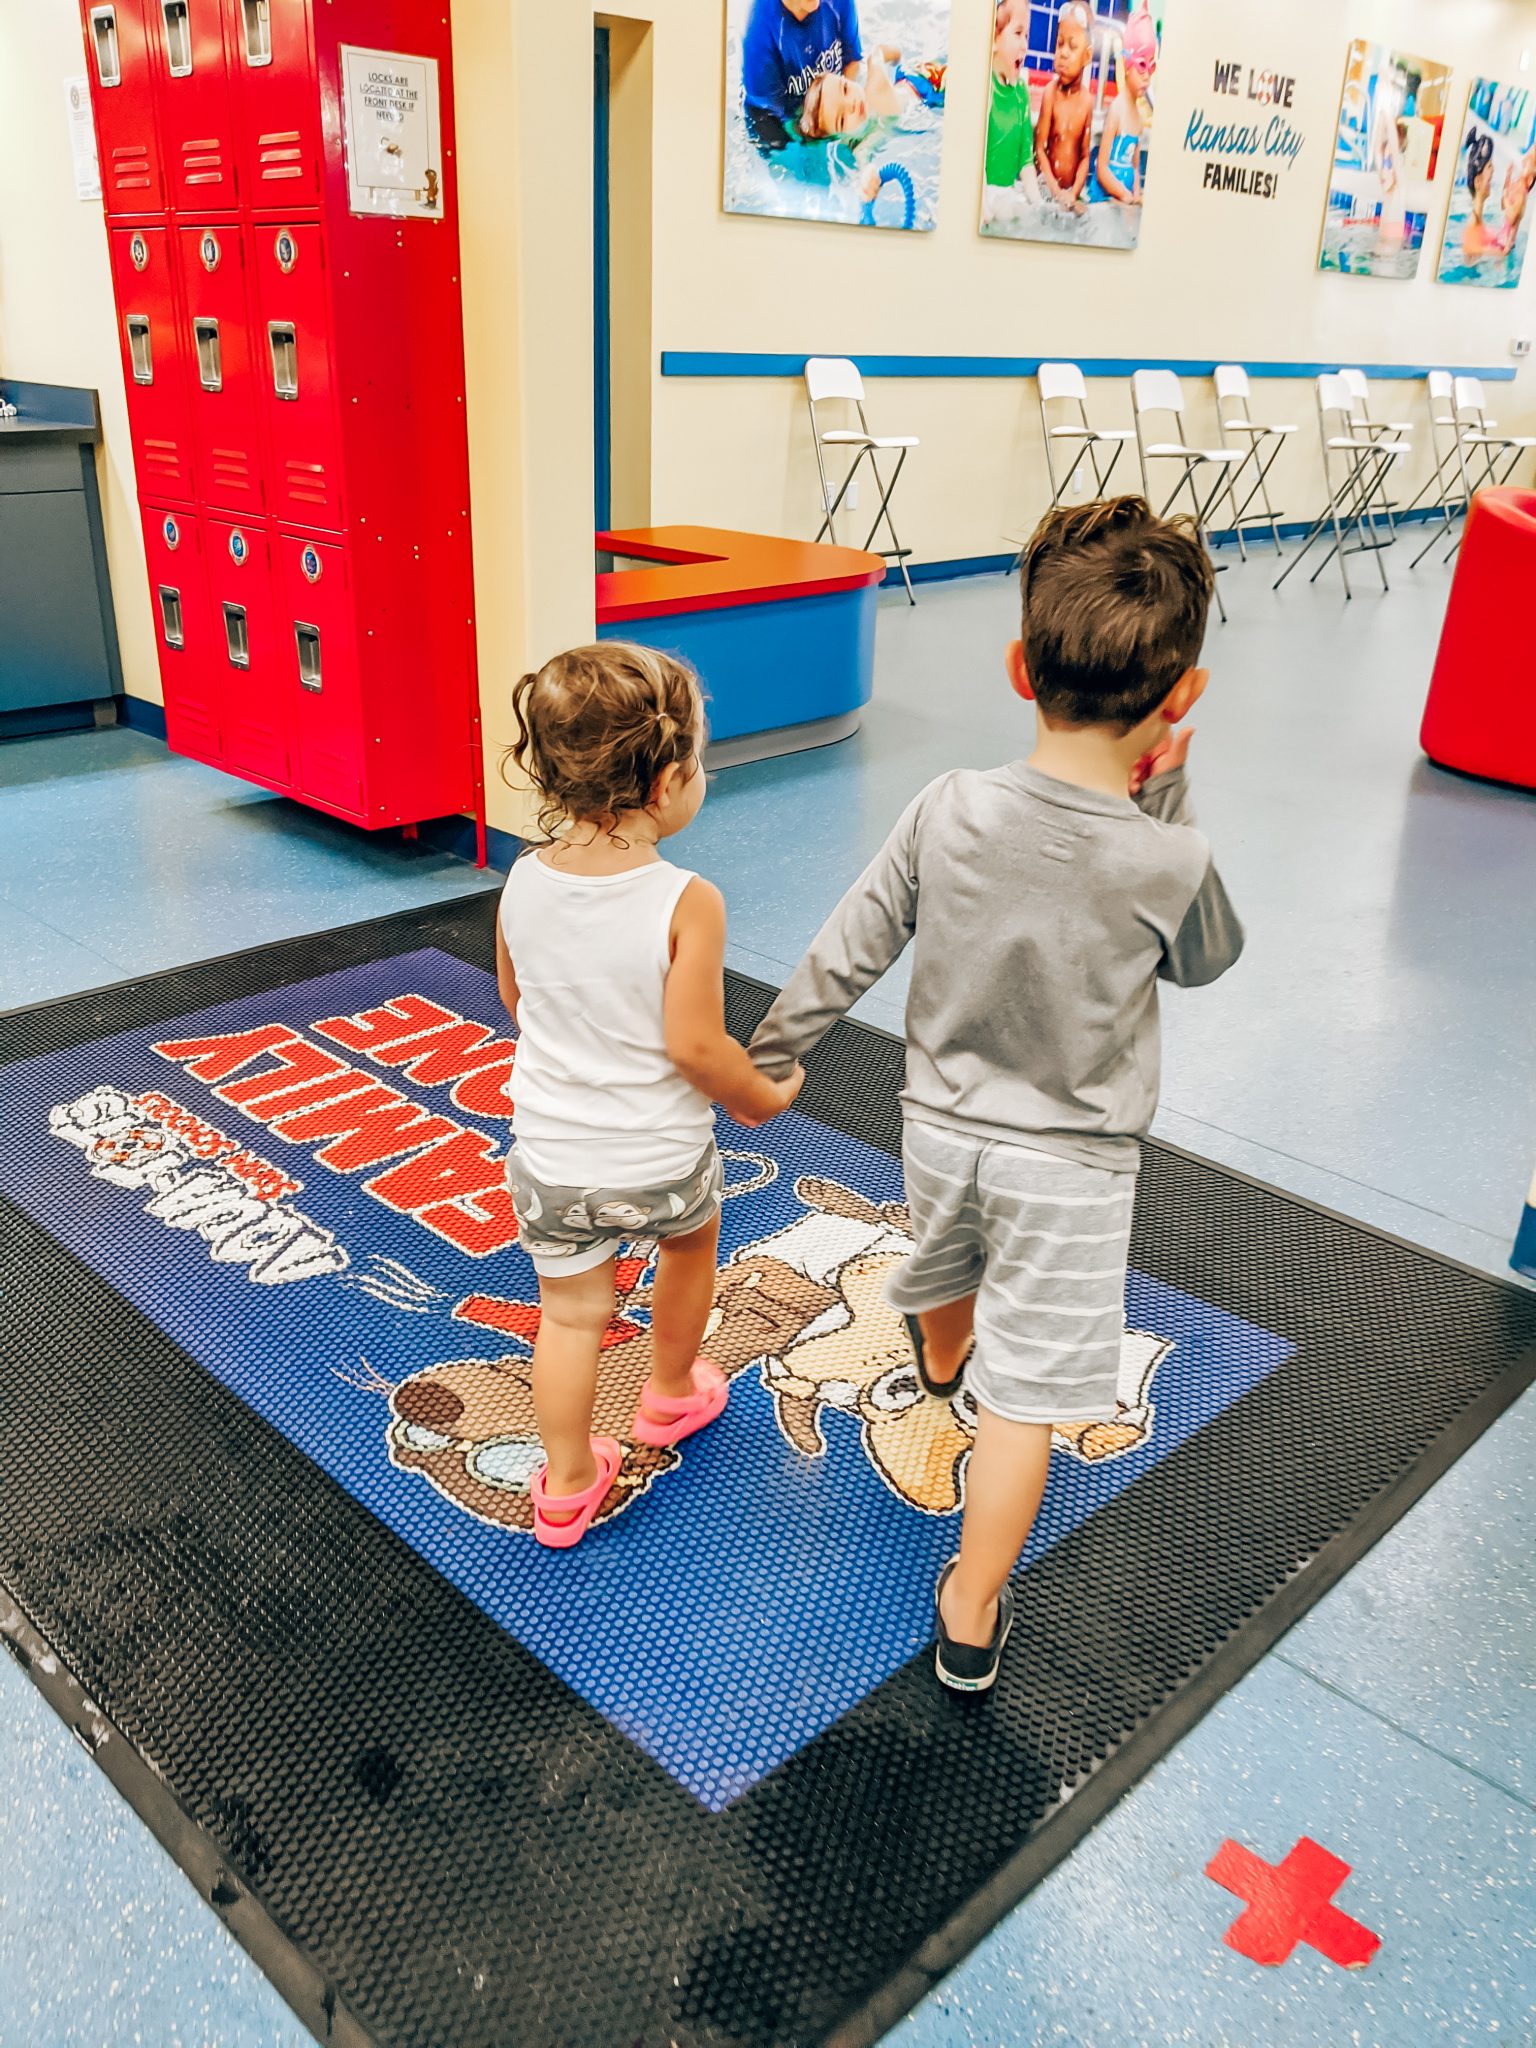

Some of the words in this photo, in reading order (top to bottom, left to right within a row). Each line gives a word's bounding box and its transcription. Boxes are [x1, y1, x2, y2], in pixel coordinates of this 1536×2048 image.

[368, 72, 393, 84] LOCKS
[395, 76, 408, 86] ARE
[395, 88, 404, 98] AT
[406, 89, 417, 100] THE
[1213, 59, 1242, 96] WE
[1247, 68, 1296, 109] LOVE
[364, 96, 387, 109] FRONT
[389, 100, 406, 110] DESK
[408, 102, 415, 112] IF
[1183, 108, 1263, 156] Kansas
[1264, 114, 1306, 171] City
[1202, 162, 1279, 199] FAMILIES!
[149, 1023, 521, 1259] FAMILY
[48, 1085, 351, 1286] AQUA-TOTS
